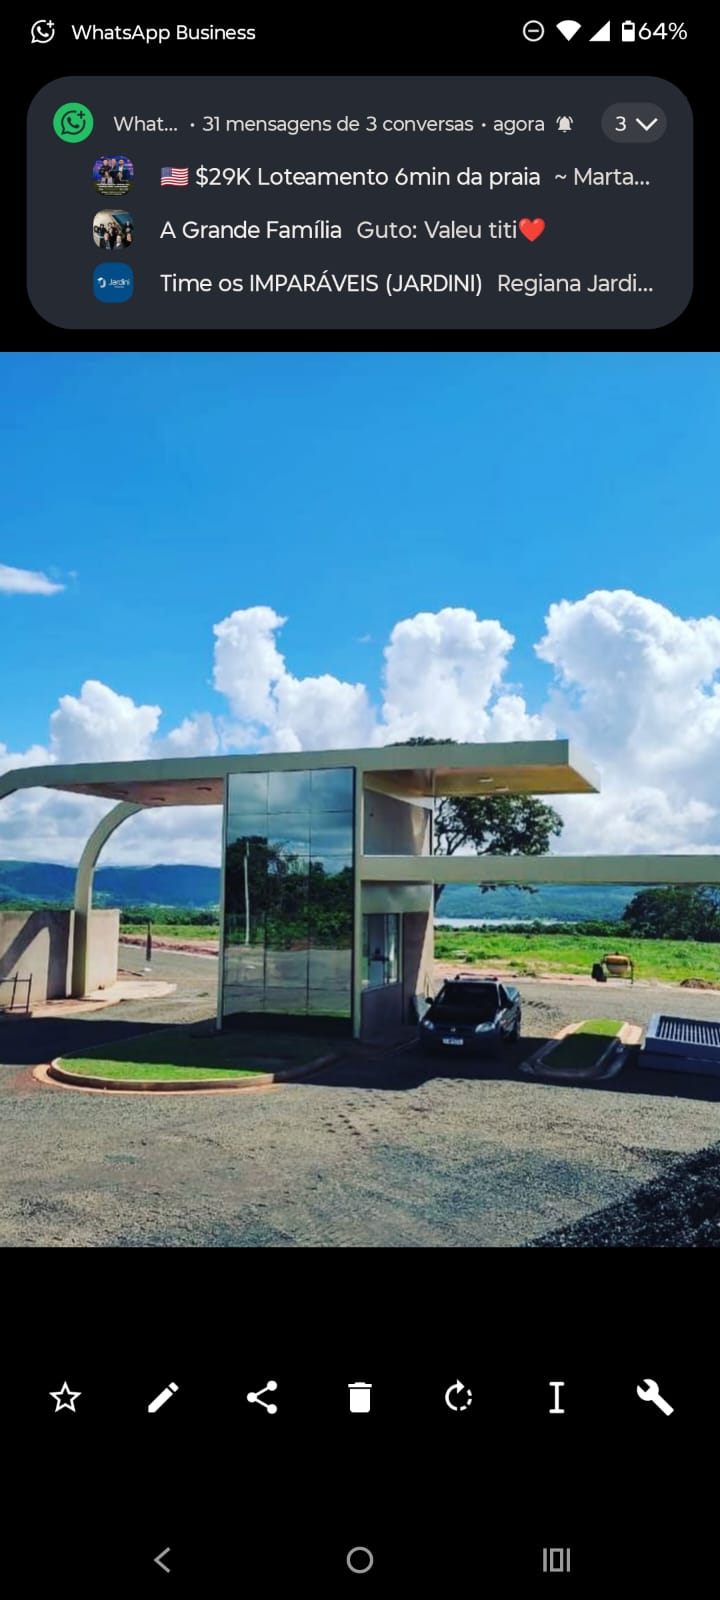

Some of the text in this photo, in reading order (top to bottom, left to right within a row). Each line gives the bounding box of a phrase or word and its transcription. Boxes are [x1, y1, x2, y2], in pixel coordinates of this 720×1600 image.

[72, 24, 256, 44] WhatsApp Business
[638, 22, 688, 41] 64%
[202, 115, 220, 132] 31
[226, 119, 332, 136] mensagens
[337, 115, 361, 132] de
[366, 115, 378, 132] 3
[382, 119, 474, 132] conversas
[493, 119, 545, 136] agora
[615, 115, 627, 132] 3
[195, 164, 252, 188] $29K
[258, 167, 389, 186] Loteamento
[394, 166, 451, 186] 6min
[456, 166, 483, 186] da
[489, 166, 541, 191] praia
[159, 219, 517, 240] A Grande Família Guto: Valeu titi
[108, 278, 131, 287] Jardini
[160, 272, 213, 293] Time
[218, 278, 244, 293] os
[250, 269, 379, 293] IMPARÁVEIS
[386, 273, 482, 297] (JARDINI)
[498, 272, 581, 297] Regiana
